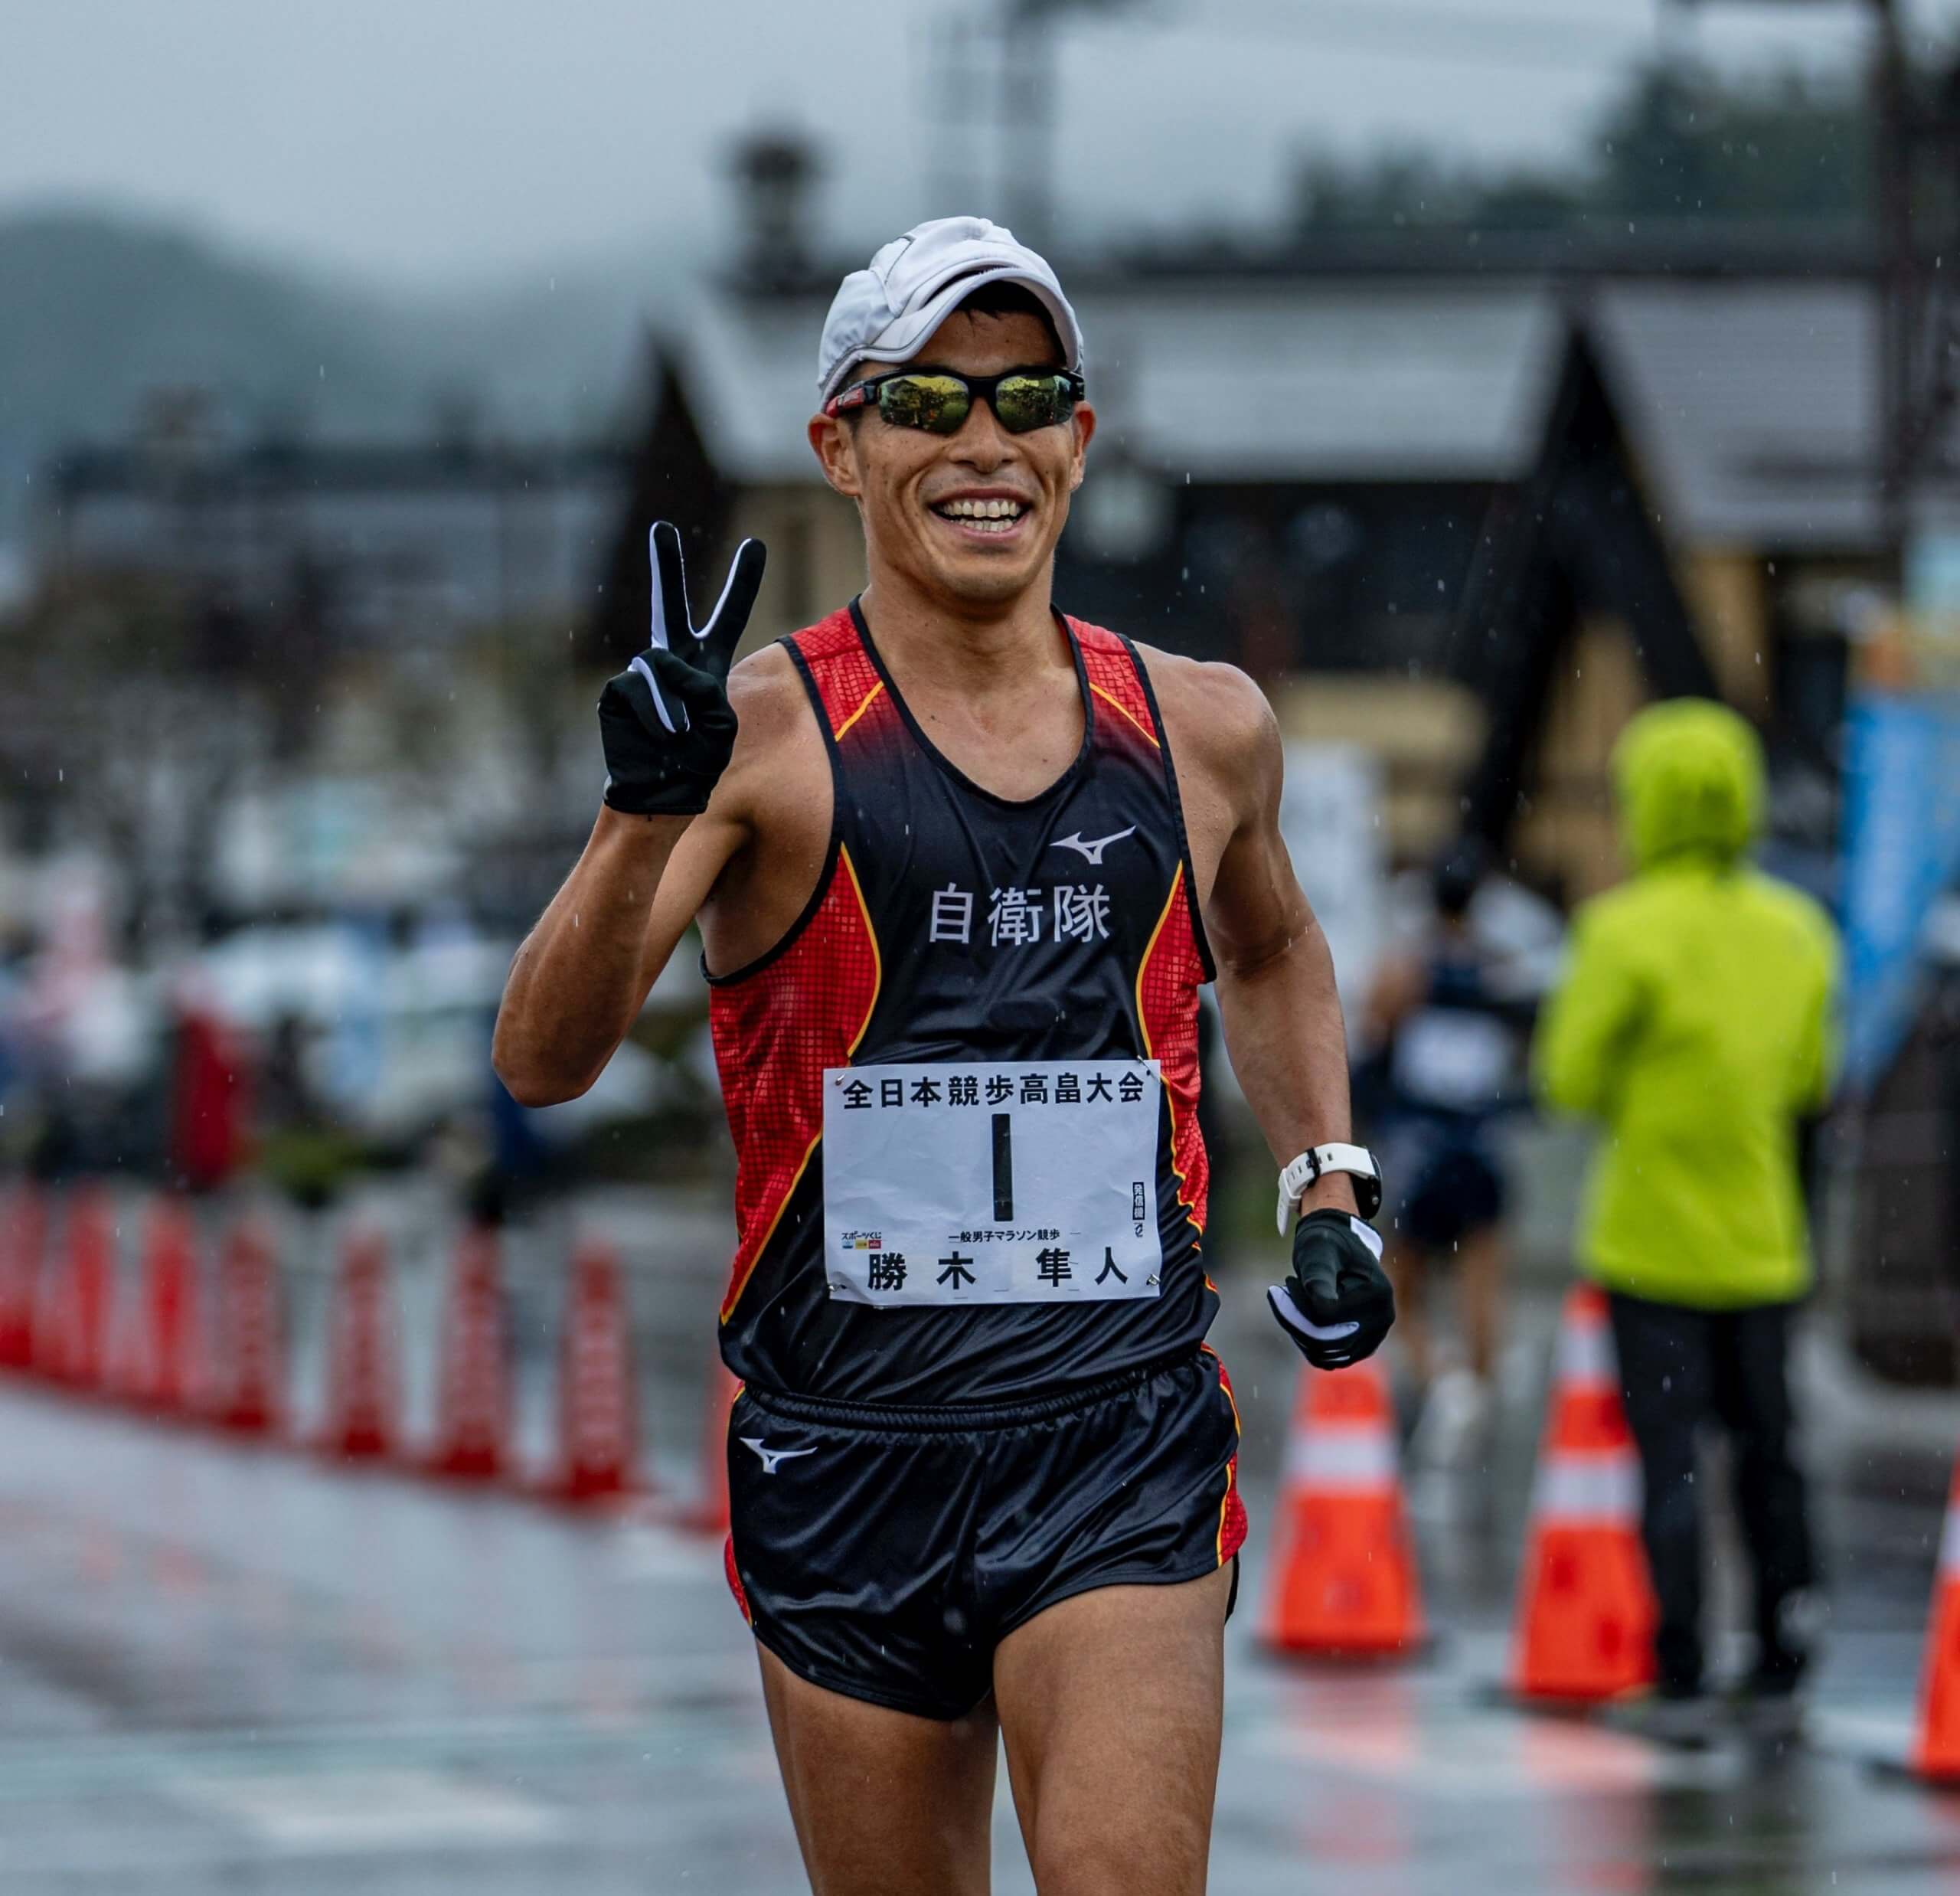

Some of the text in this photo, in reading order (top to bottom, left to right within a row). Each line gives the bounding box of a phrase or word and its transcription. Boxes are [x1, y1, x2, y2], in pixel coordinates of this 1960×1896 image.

[929, 882, 1110, 946] 自衛隊
[843, 1071, 1145, 1109] 全日本競歩高畠大会
[991, 1113, 1014, 1221] 1
[841, 1231, 882, 1240] スポーツくじ
[948, 1228, 1060, 1243] 一般男子マラソン競歩
[867, 1247, 1128, 1290] 勝木 隼人
